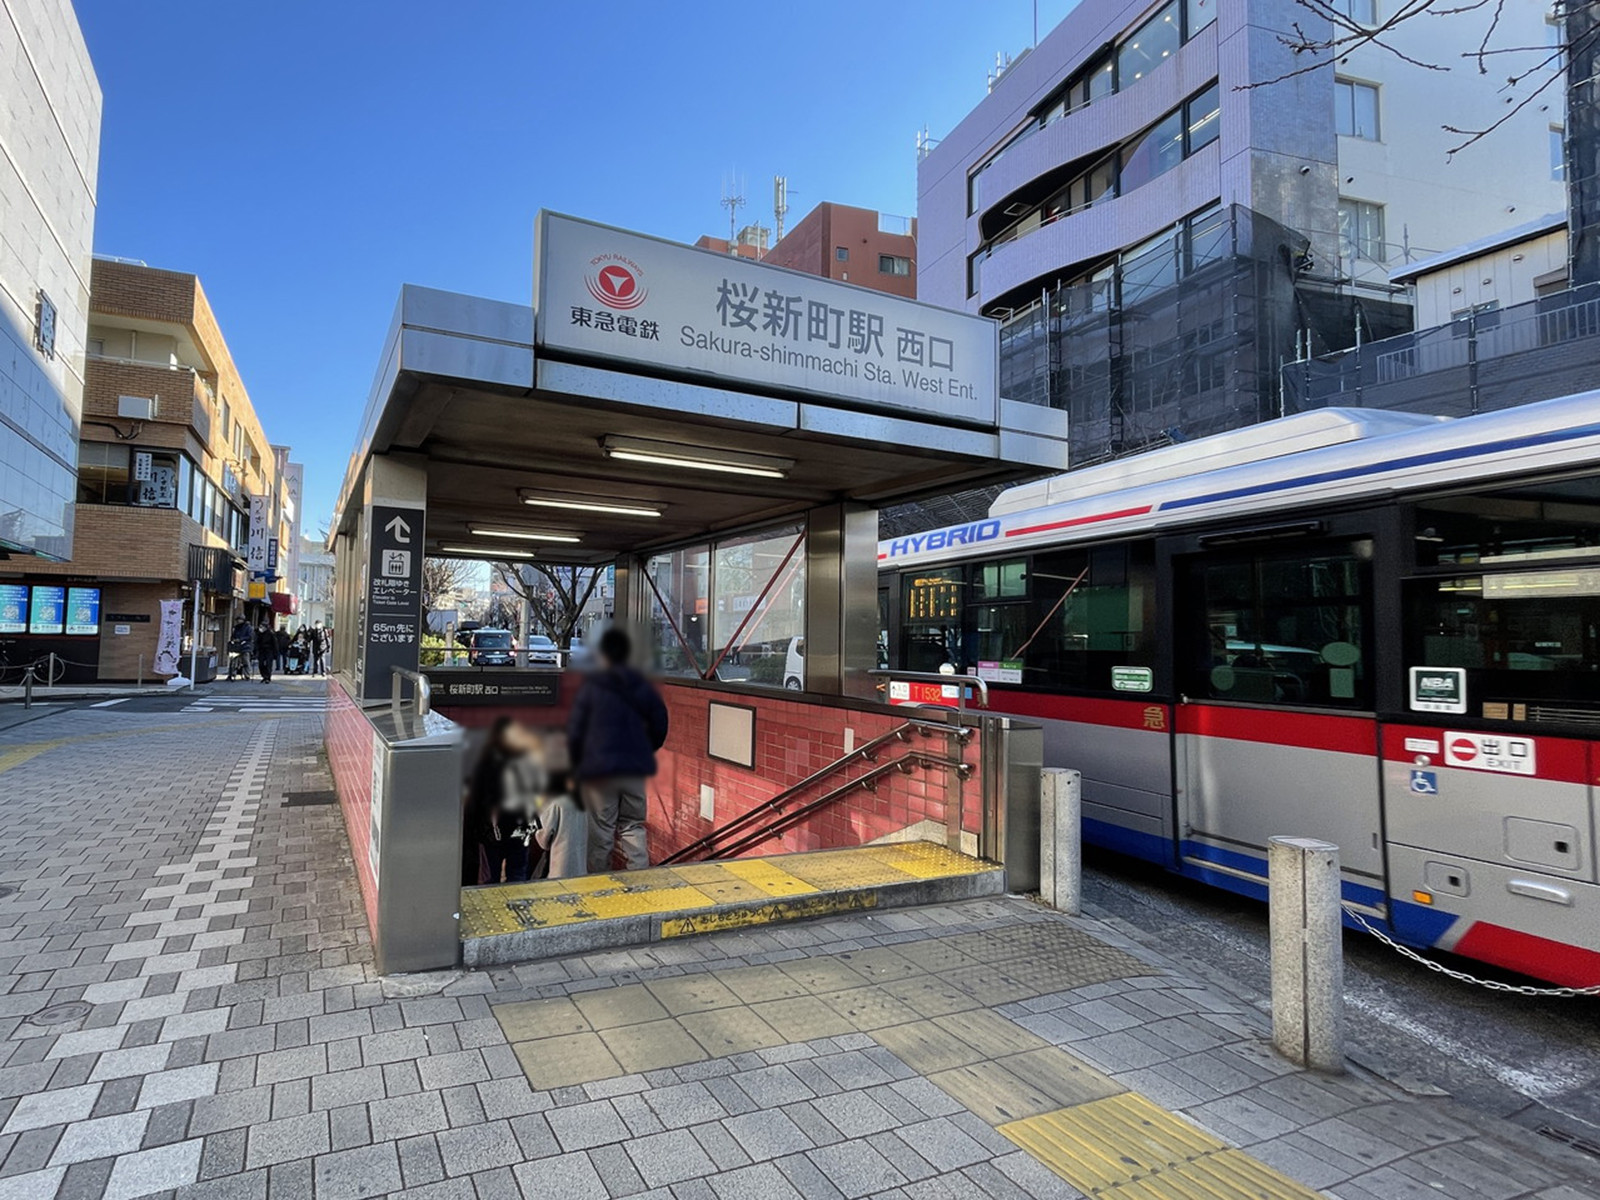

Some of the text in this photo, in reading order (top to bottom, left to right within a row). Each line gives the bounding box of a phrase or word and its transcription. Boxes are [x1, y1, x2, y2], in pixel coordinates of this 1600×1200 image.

[590, 253, 644, 277] TOKYU RAILWAYS
[569, 306, 660, 341] 東急電鉄
[716, 279, 954, 372] 桜新町駅 西口
[680, 326, 978, 400] Sakura-shimmachi Sta. West Ent.
[890, 520, 1001, 557] HYBRID
[372, 578, 410, 588] 改札階ゆき
[373, 587, 418, 596] エレベーター
[372, 623, 415, 633] 65m先に
[370, 633, 415, 643] ございます
[449, 684, 484, 695] 桜新町駅
[1481, 738, 1527, 758] 出口
[1486, 758, 1521, 770] EXIT
